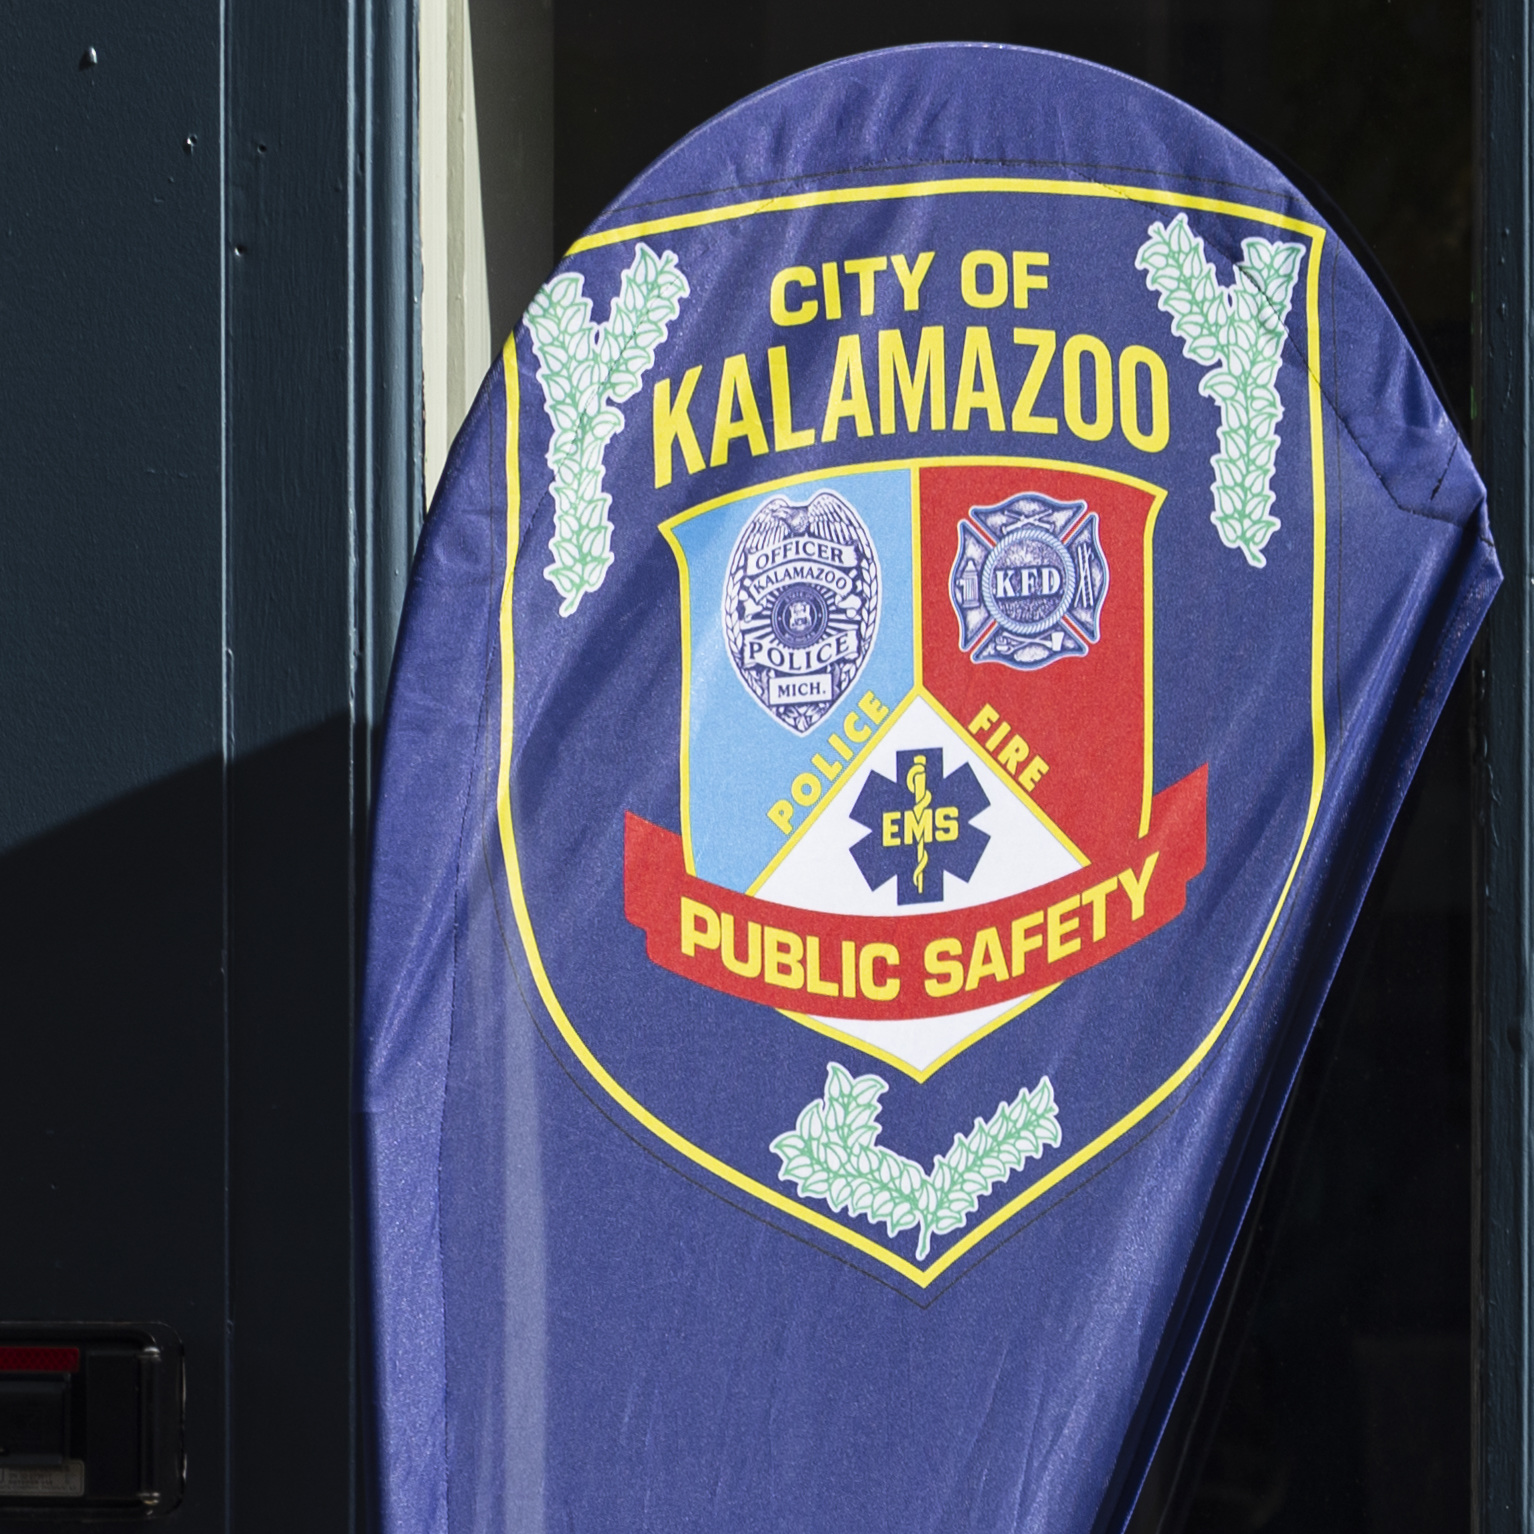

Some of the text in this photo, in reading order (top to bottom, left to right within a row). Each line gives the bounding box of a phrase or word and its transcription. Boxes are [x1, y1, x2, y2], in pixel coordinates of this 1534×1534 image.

[768, 249, 1050, 328] CITY OF
[653, 325, 1171, 489] KALAMAZOO
[755, 540, 845, 570] OFFICER
[753, 566, 848, 596] KALAMAZOO
[995, 567, 1061, 599] KFD
[749, 633, 850, 671] POLICE
[777, 683, 827, 699] MICH.
[766, 689, 890, 836] POLICE
[966, 703, 1050, 793] FIRE
[882, 806, 960, 847] EMS
[680, 850, 1160, 1002] PUBLIC SAFETY
